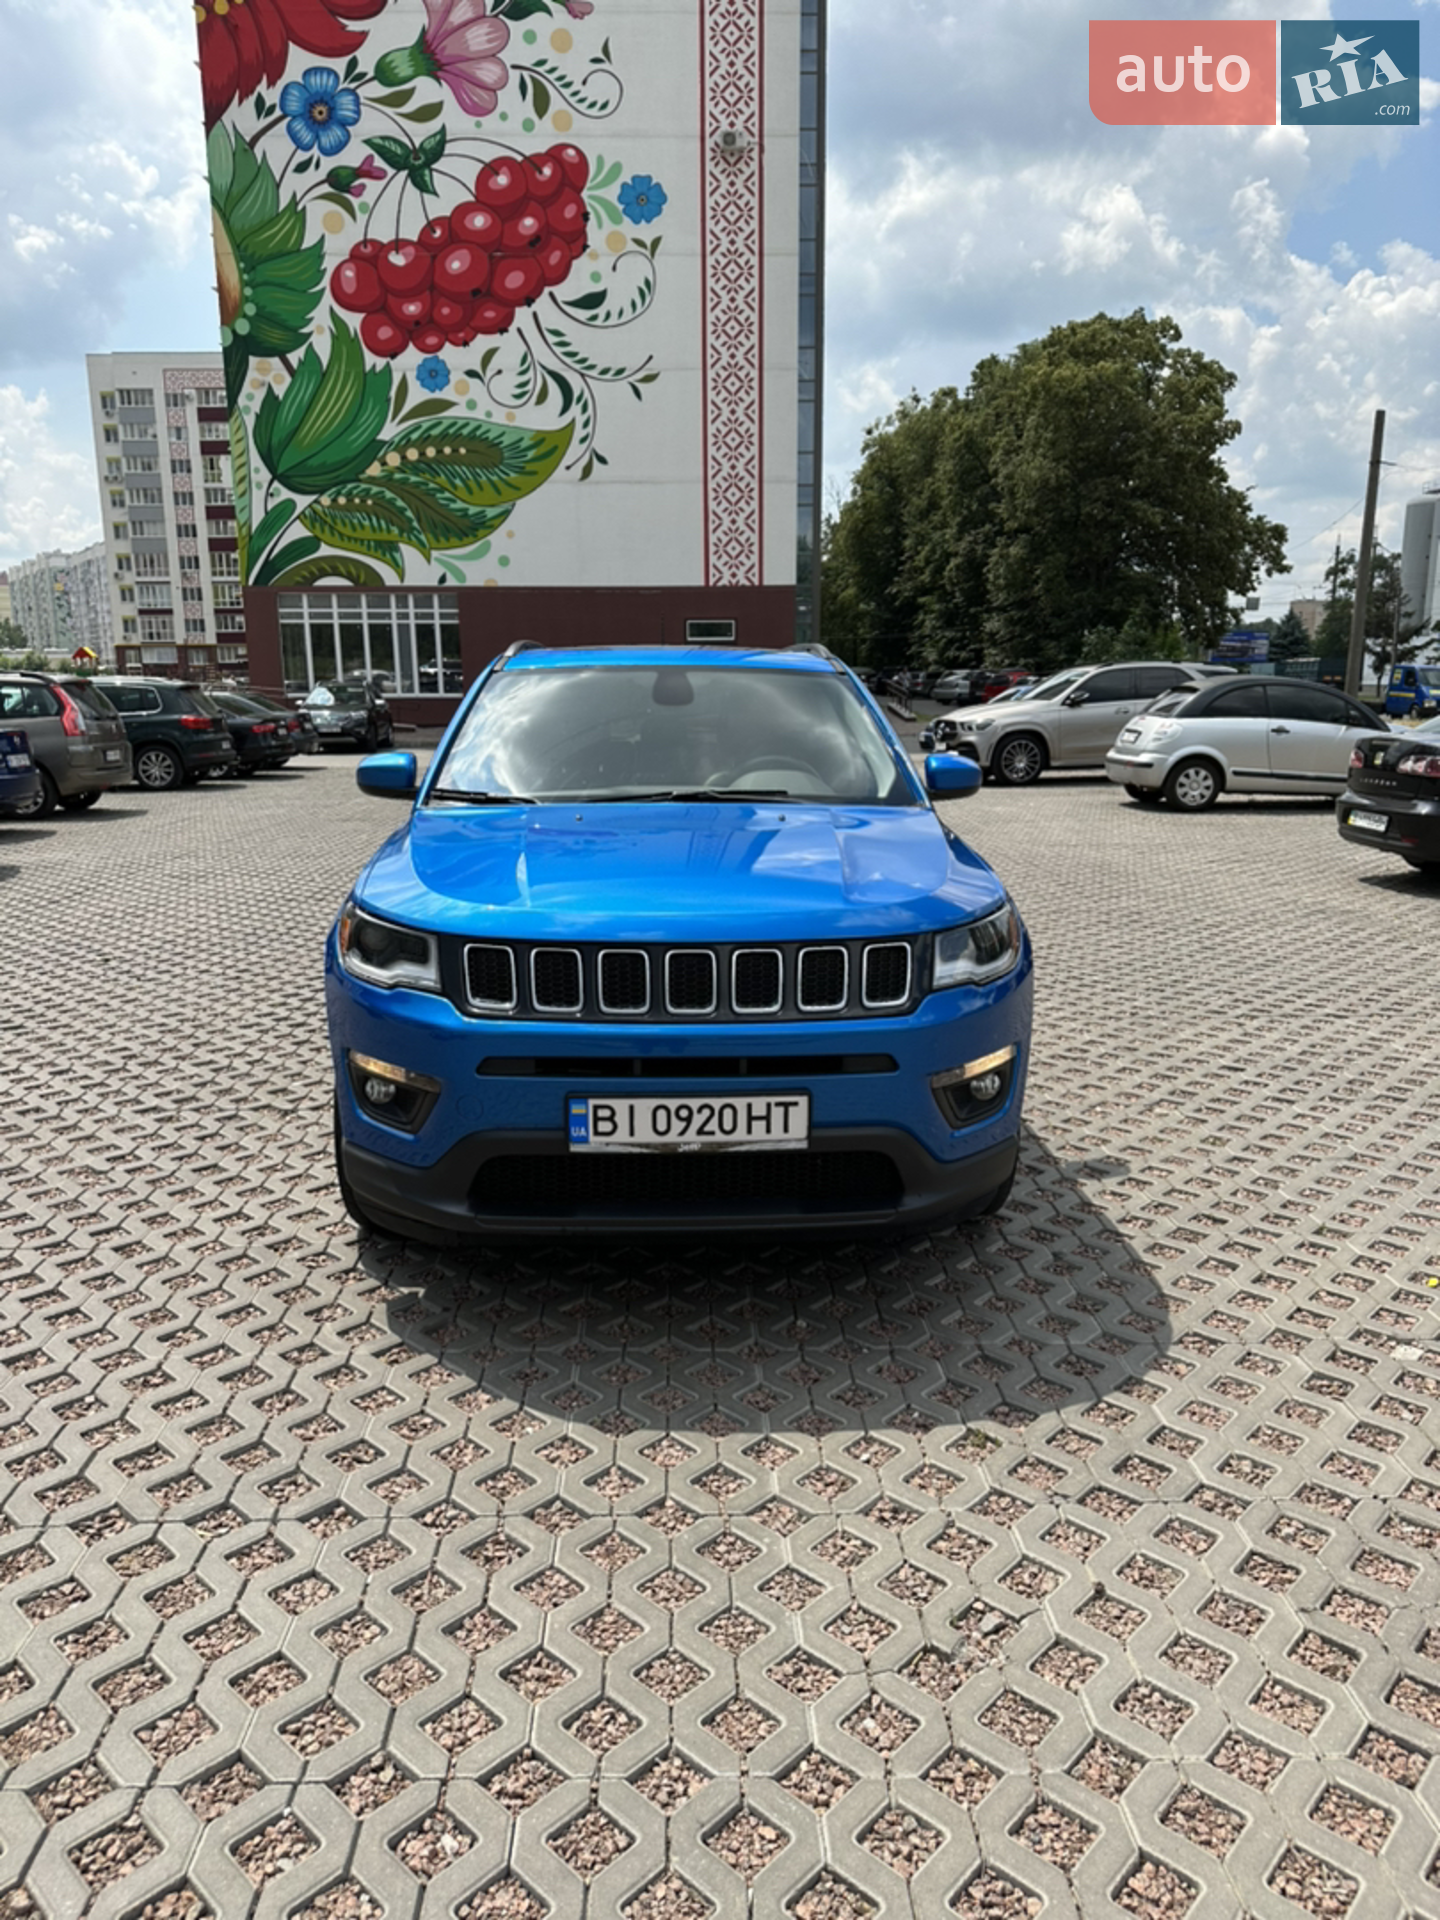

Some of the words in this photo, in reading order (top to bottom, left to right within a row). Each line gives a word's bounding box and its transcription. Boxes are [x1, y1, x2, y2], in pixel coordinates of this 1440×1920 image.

[592, 1104, 635, 1138] BI
[651, 1103, 738, 1136] 0920
[746, 1101, 799, 1135] HT
[571, 1126, 587, 1138] UA
